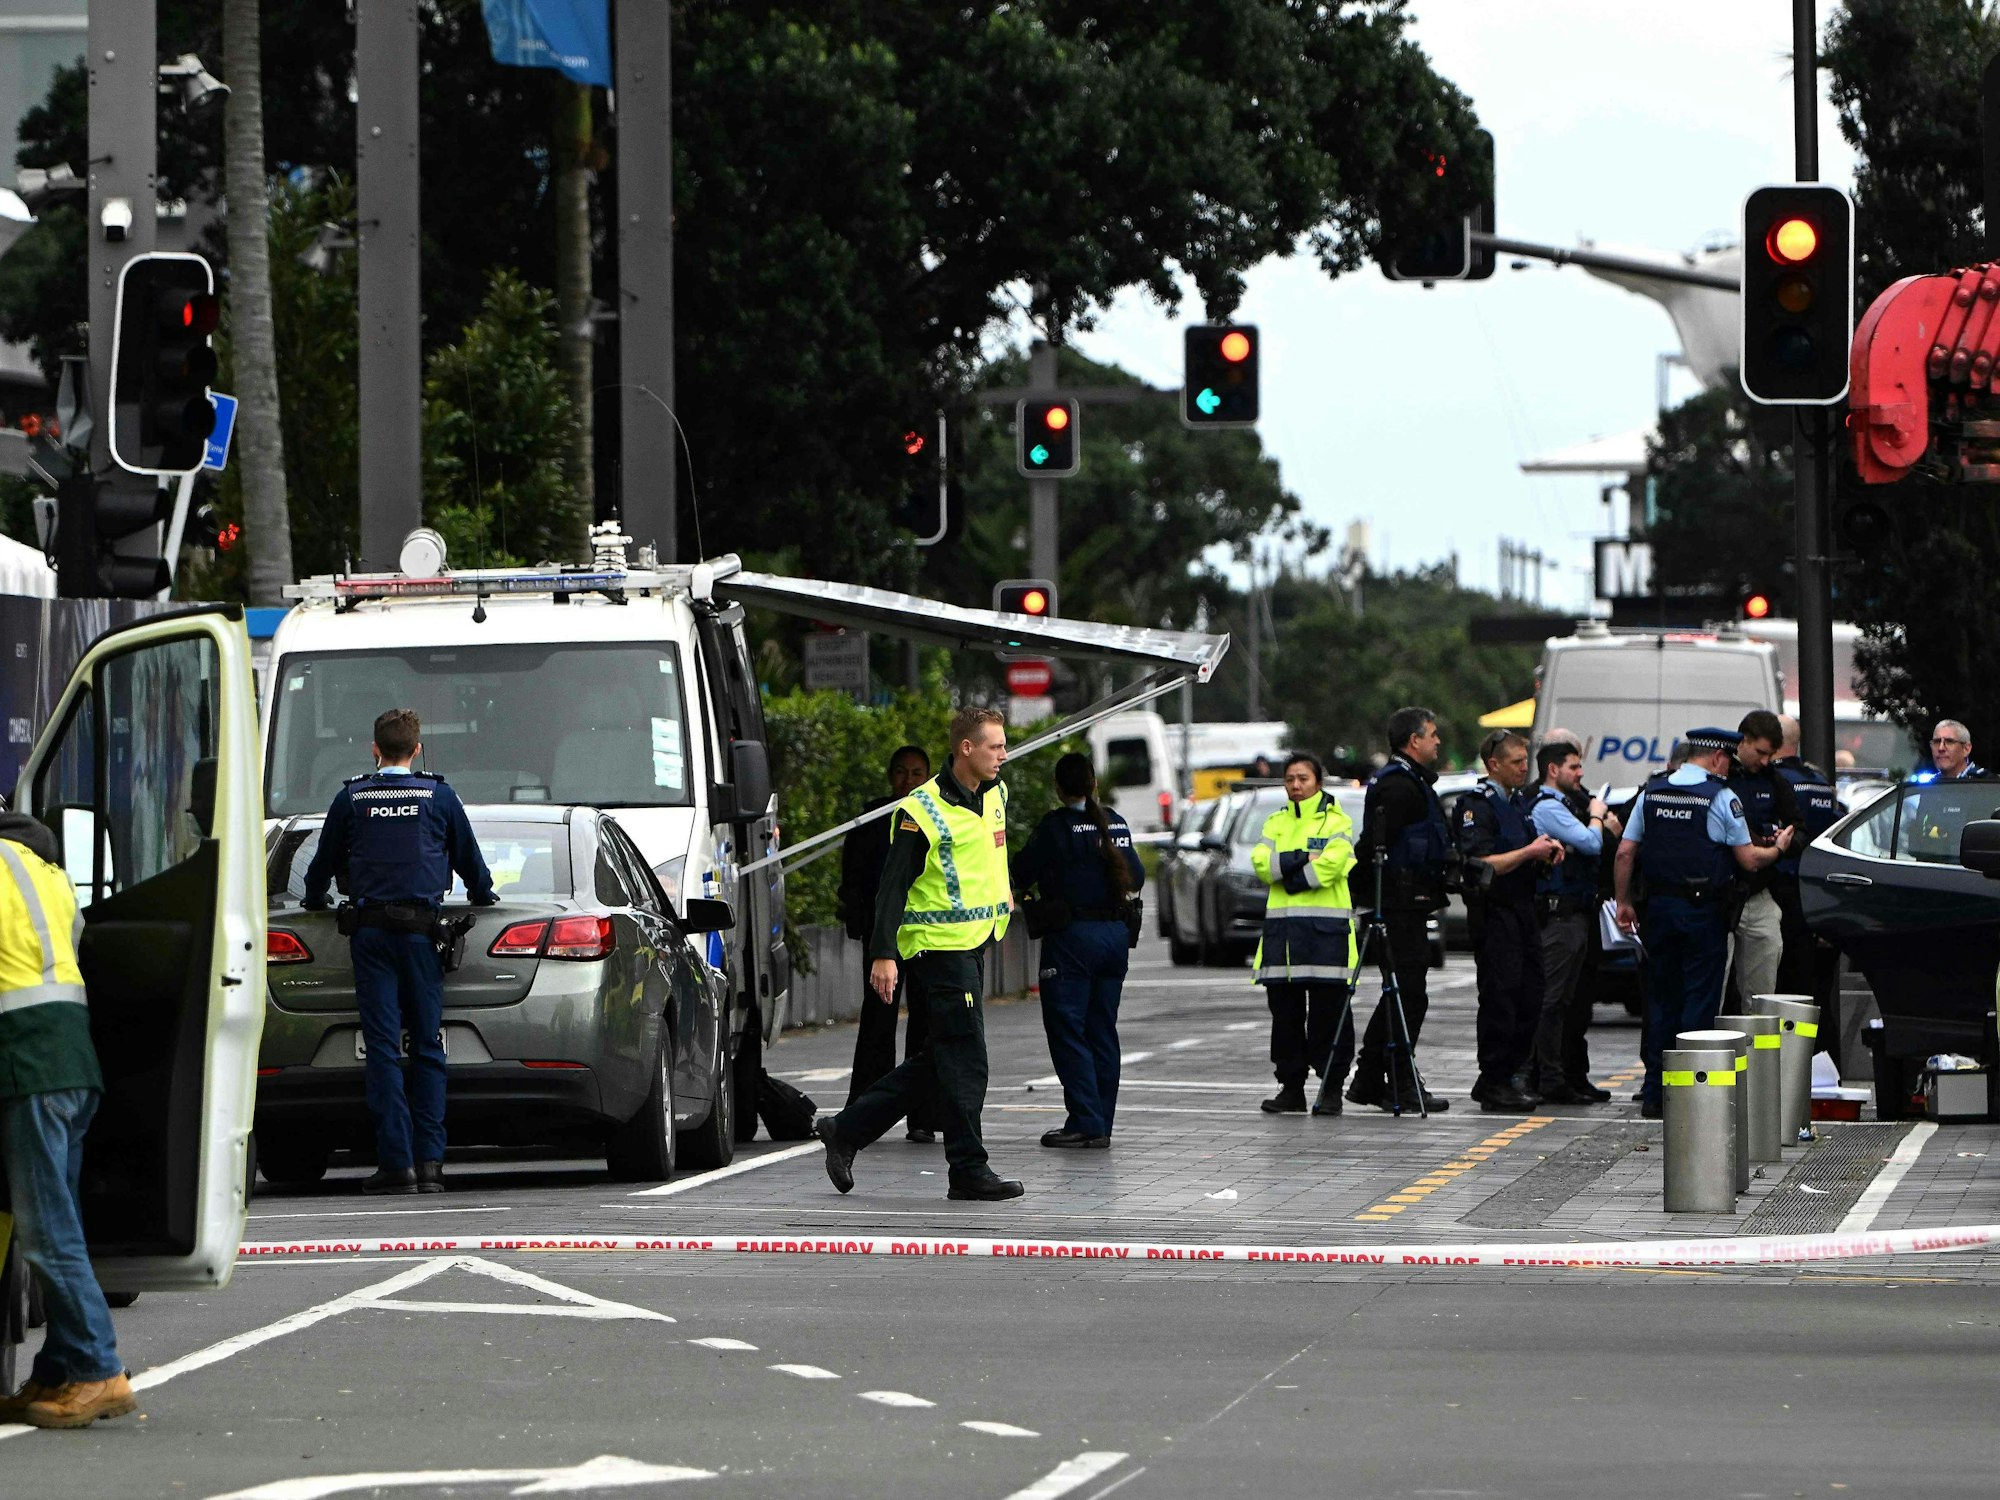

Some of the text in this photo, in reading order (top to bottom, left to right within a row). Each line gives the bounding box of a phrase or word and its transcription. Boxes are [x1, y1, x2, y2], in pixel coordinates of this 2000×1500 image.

[1808, 797, 1832, 808] POLICE
[370, 805, 419, 817] POLICE
[1656, 807, 1693, 820] POLICE
